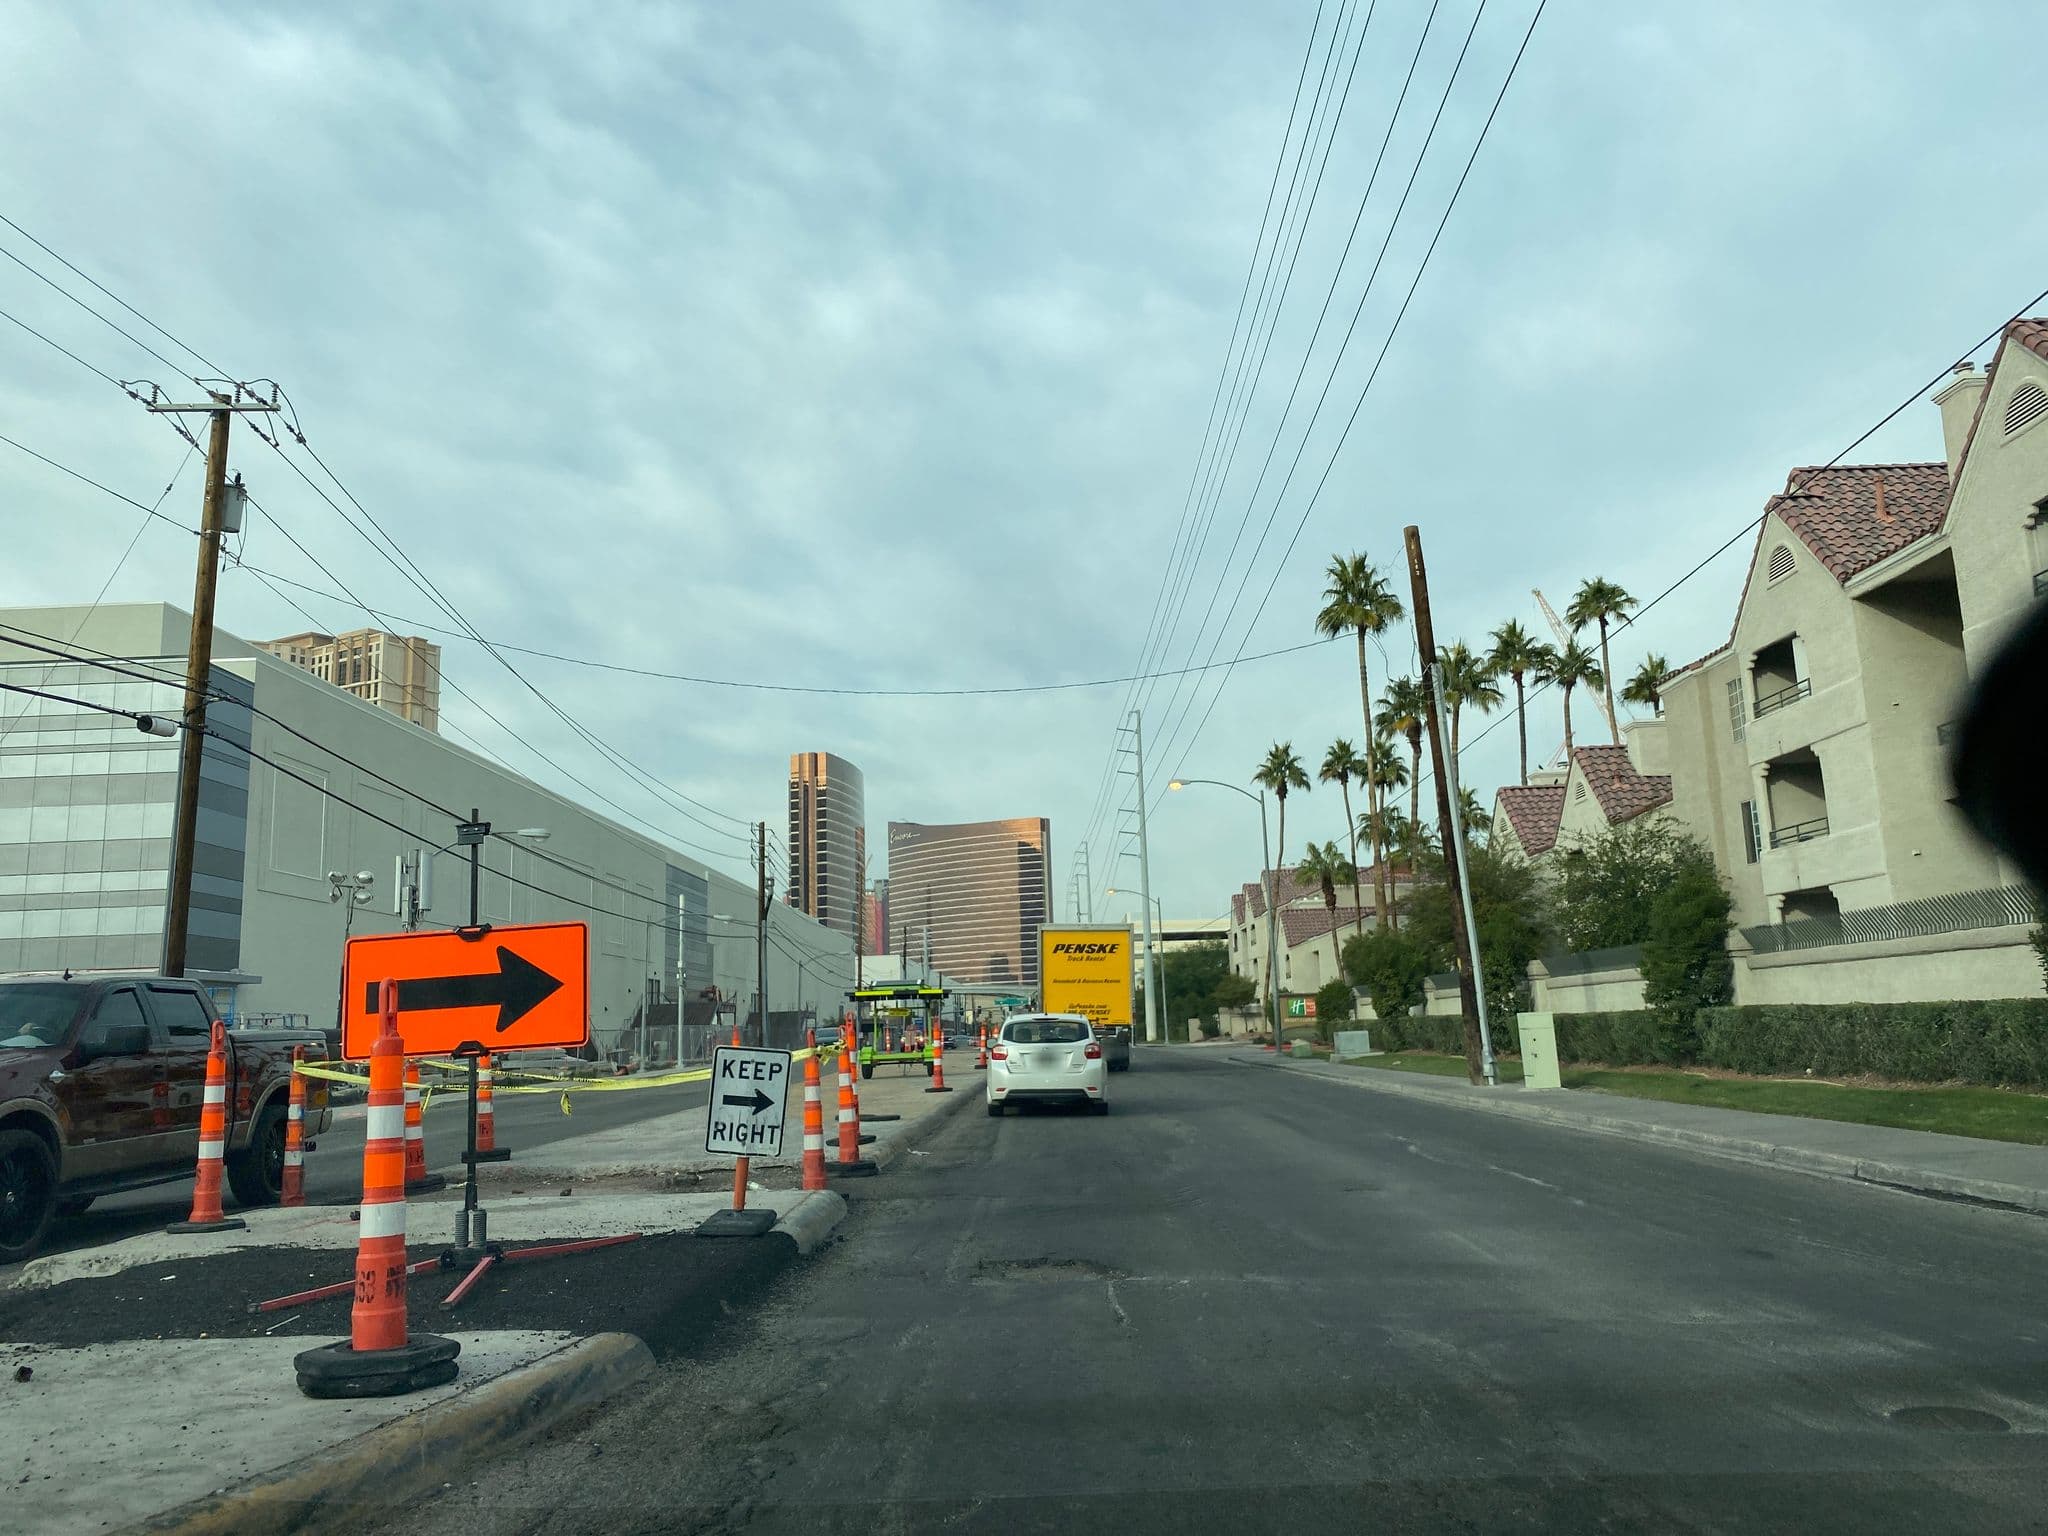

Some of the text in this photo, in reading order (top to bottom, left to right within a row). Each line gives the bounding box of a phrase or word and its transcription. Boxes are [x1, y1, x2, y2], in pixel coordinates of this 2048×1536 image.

[1052, 943, 1120, 954] PENSKE
[722, 1059, 783, 1081] KEEP
[713, 1121, 780, 1144] RIGHT
